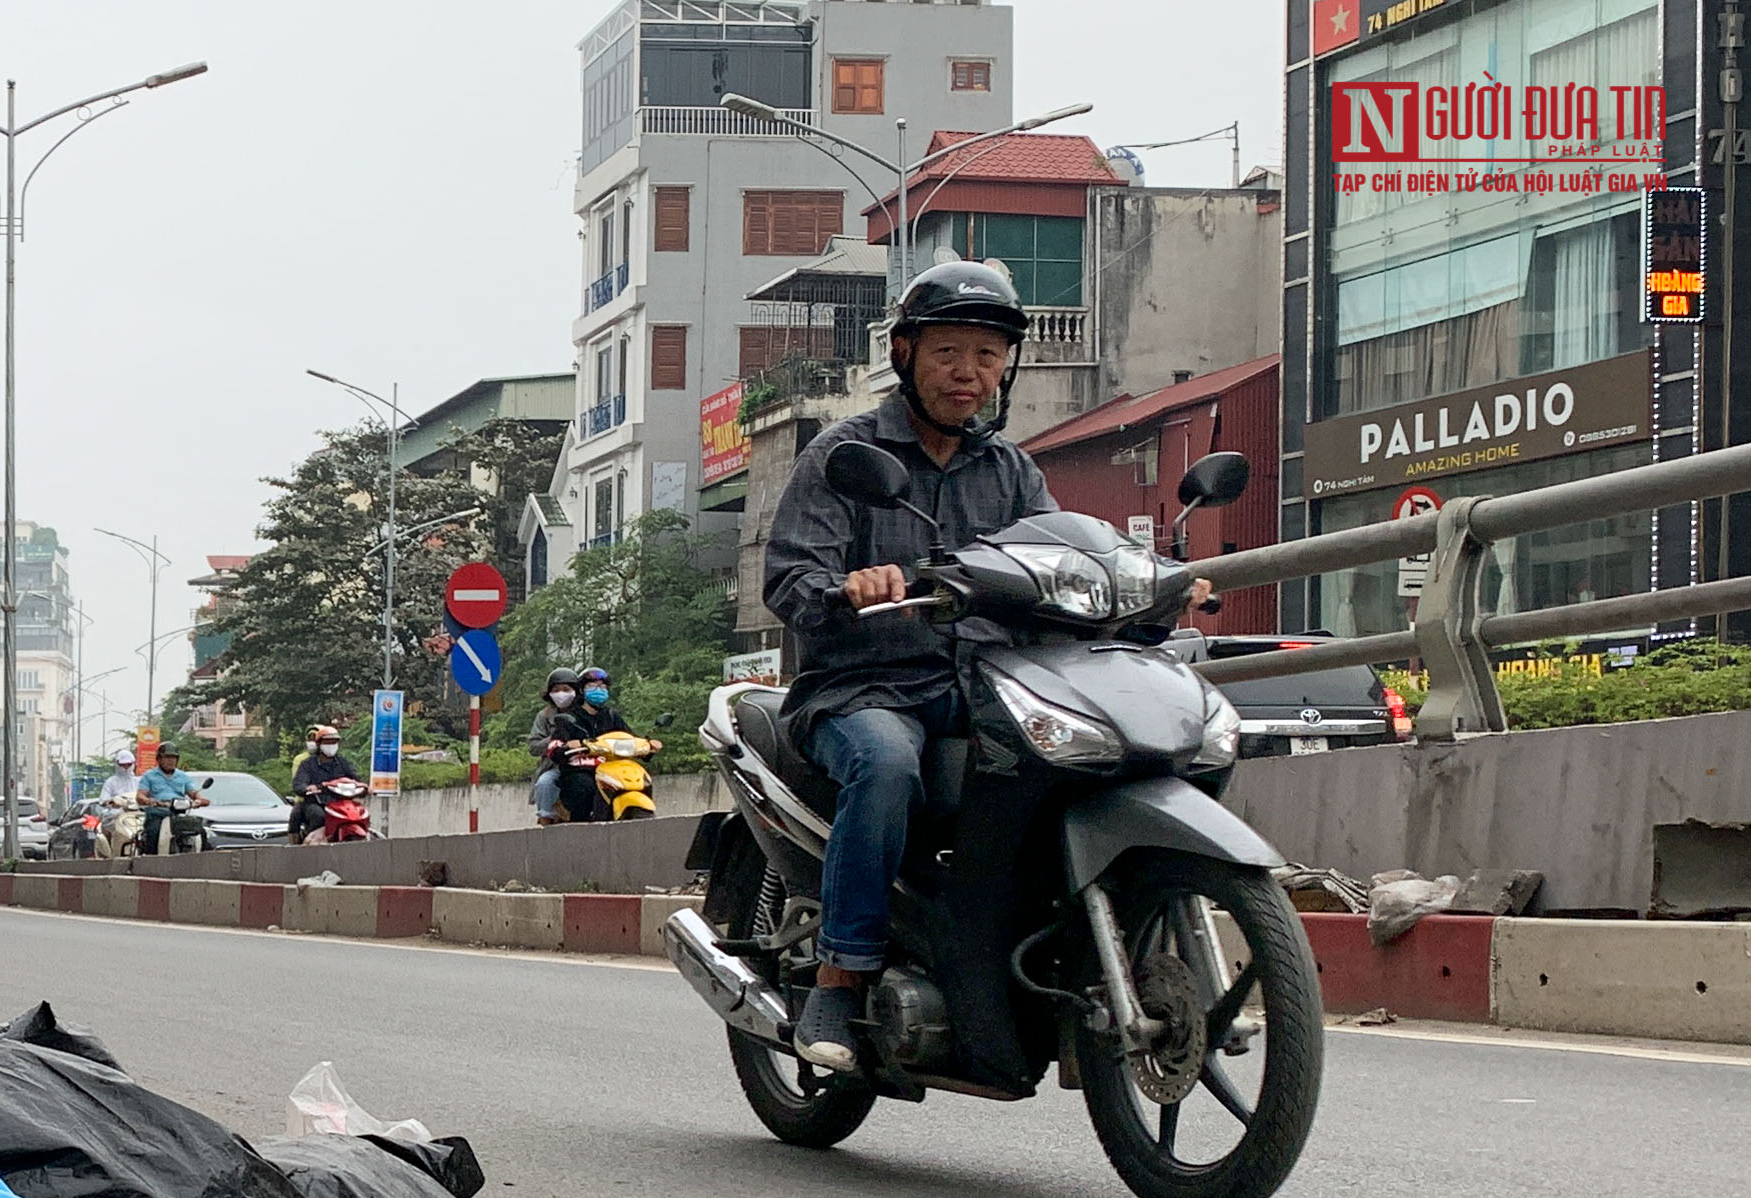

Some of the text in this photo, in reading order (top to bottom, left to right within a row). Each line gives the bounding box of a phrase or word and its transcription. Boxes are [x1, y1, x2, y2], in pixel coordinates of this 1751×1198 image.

[1651, 268, 1704, 292] HOÀNG
[1662, 295, 1689, 316] GIA
[1361, 382, 1574, 464] PALLADIO
[1405, 443, 1520, 477] AMAZING HOME
[1324, 481, 1337, 491] 74
